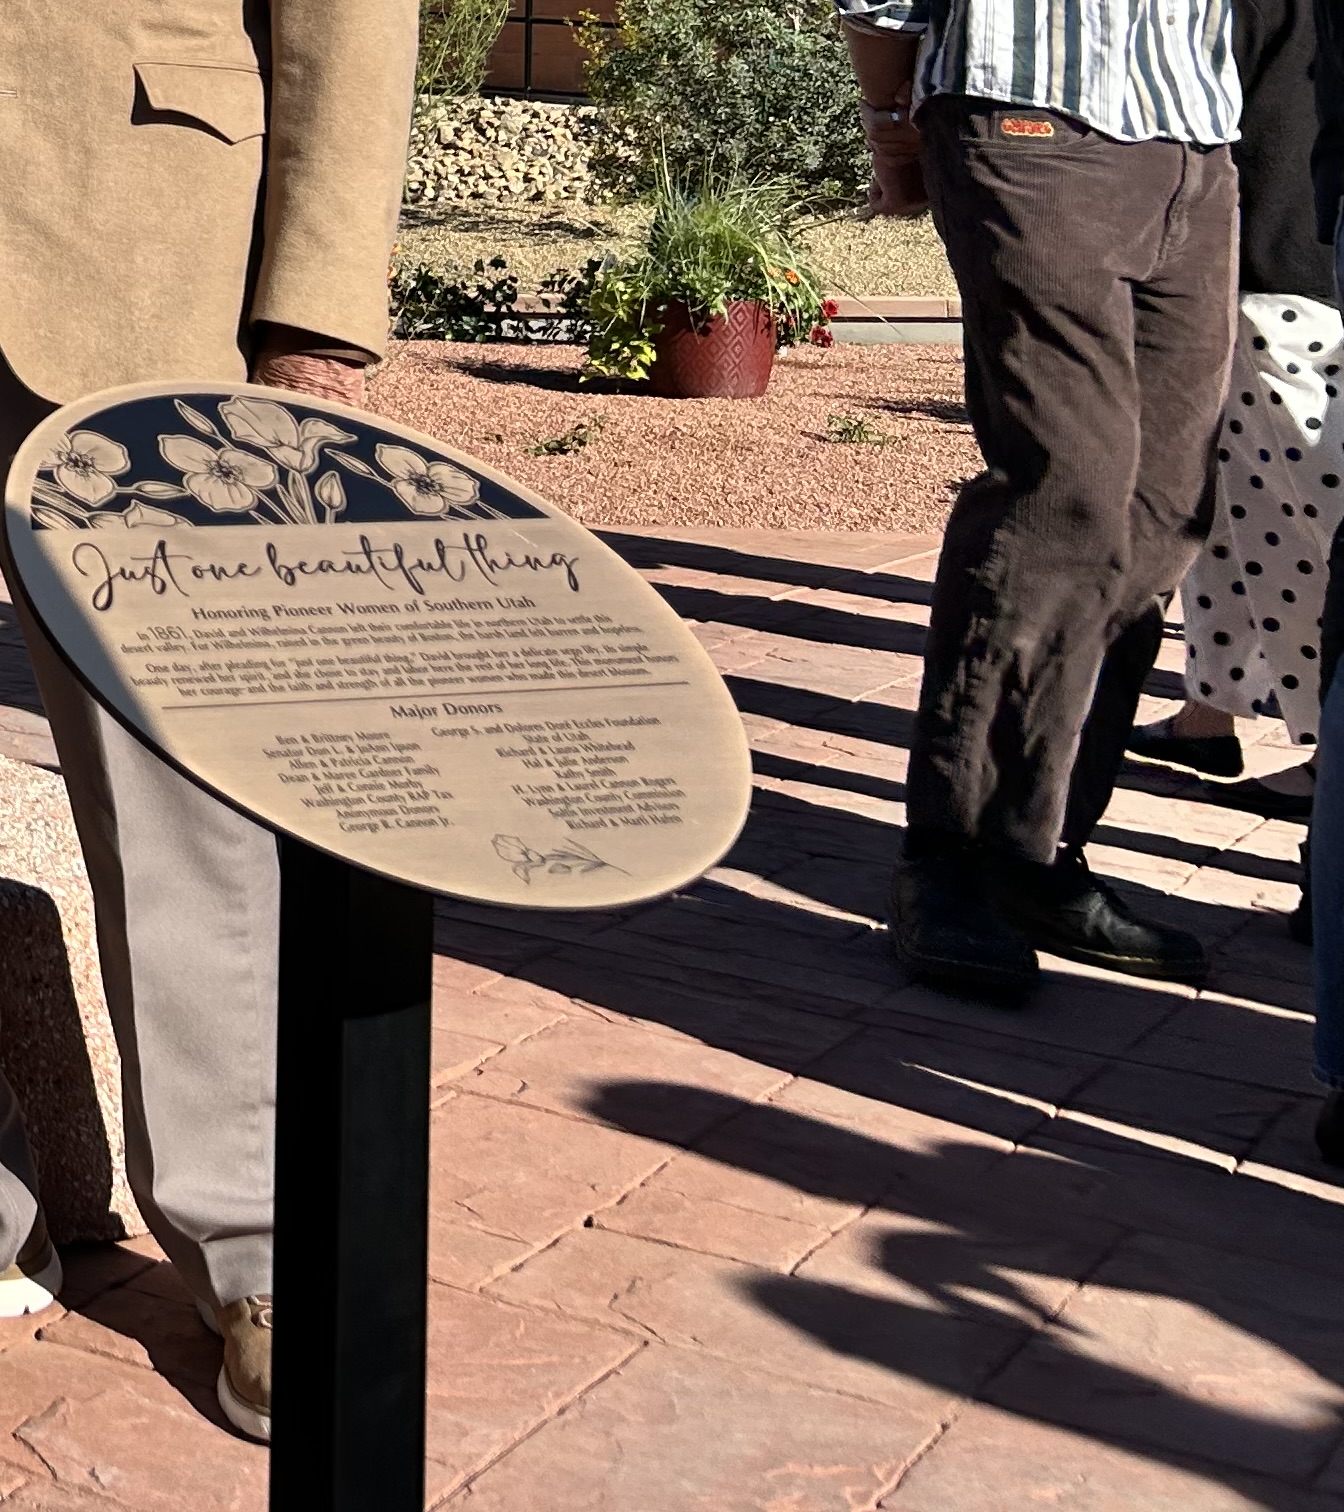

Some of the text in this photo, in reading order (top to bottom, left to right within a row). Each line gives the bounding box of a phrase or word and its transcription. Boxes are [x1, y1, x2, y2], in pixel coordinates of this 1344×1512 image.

[72, 533, 579, 611] Just one beautiful thing
[191, 596, 536, 621] Honoring Pioneer Women of Southern Utah
[136, 631, 151, 640] In
[147, 625, 193, 642] 1861,
[191, 628, 226, 639] David
[227, 627, 248, 638] and
[246, 625, 308, 637] Wilhelmina
[307, 623, 348, 635] Cannon
[367, 622, 393, 632] their
[393, 619, 453, 631] comfortable
[452, 619, 471, 629] life
[470, 618, 484, 628] in
[483, 617, 527, 627] northern
[525, 616, 554, 626] Utah
[552, 616, 566, 626] to
[120, 643, 154, 654] desert
[189, 641, 210, 651] For
[321, 636, 340, 647] the
[457, 630, 476, 640] the
[144, 662, 171, 674] One
[198, 660, 223, 672] after
[335, 654, 384, 666] beautiful
[418, 651, 453, 662] David
[449, 649, 493, 662] brought
[520, 647, 560, 659] delicate
[130, 675, 169, 688] beauty
[170, 672, 216, 686] renewed
[214, 672, 237, 683] her
[453, 661, 474, 672] the
[176, 686, 199, 697] her
[267, 682, 287, 693] the
[314, 679, 336, 691] and
[405, 675, 425, 687] the
[389, 701, 504, 720] Major Donors
[431, 726, 470, 739] George
[483, 723, 504, 735] and
[602, 715, 662, 728] Foundation
[299, 735, 311, 744] &
[353, 730, 391, 741] Moore
[522, 730, 592, 744] State of Utah
[262, 747, 304, 759] Senator
[495, 740, 636, 758] Richard & Whitehead
[288, 754, 416, 769] Allen & Patricia Cannon
[543, 758, 555, 768] &
[580, 754, 630, 766] Anderson
[277, 764, 440, 783] Dean & Gardner Family
[552, 766, 617, 780] Kathy Smith
[336, 782, 347, 793] &
[346, 780, 386, 792] Connie
[555, 782, 566, 792] &
[299, 795, 367, 809] Washington
[366, 791, 407, 805] County
[429, 789, 454, 800] Tax
[521, 796, 586, 808] Washington
[622, 788, 687, 801] Commission
[336, 803, 441, 821] Anonymous Donors
[576, 803, 637, 817] Investment
[339, 821, 380, 834] George
[394, 816, 440, 829] Cannon
[563, 816, 609, 830] Richard
[608, 817, 620, 828] &
